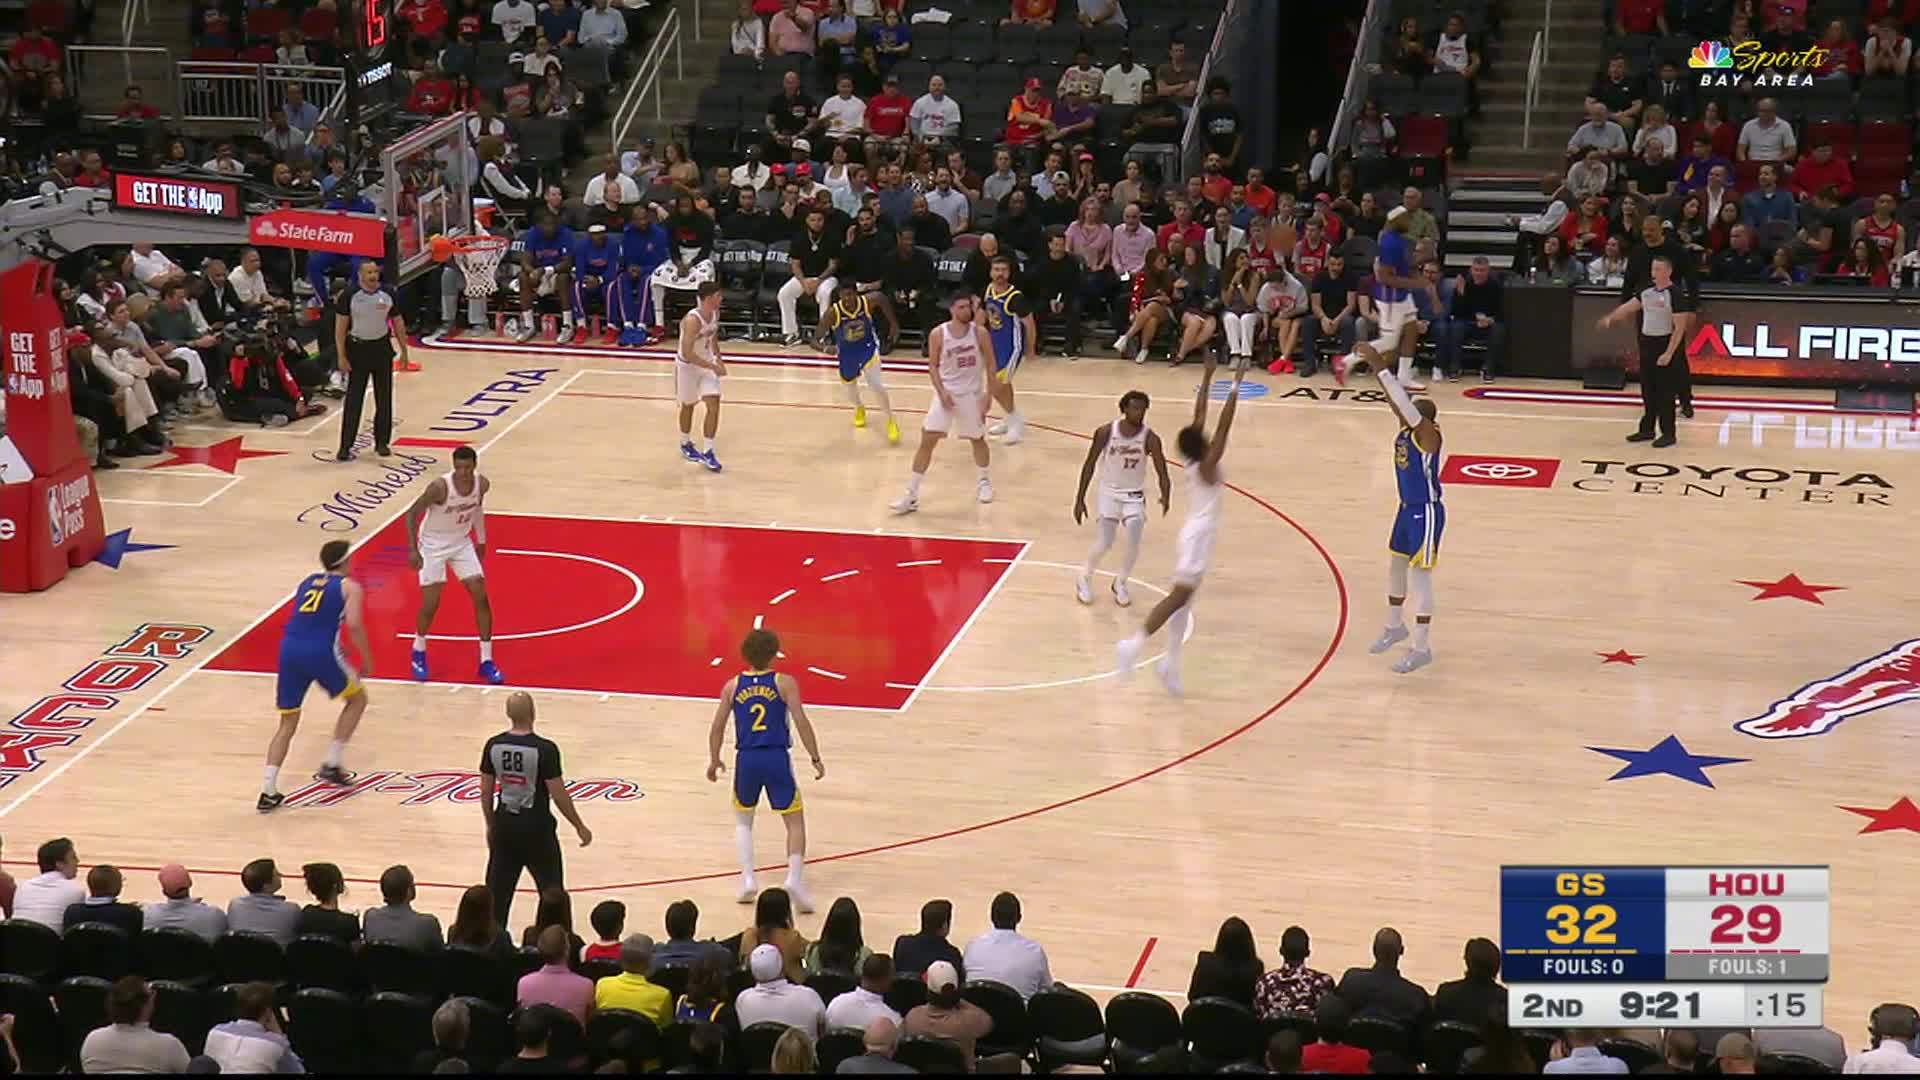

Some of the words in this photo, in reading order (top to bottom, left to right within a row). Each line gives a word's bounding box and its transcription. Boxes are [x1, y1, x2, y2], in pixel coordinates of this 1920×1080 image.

[133, 181, 158, 205] GET
[160, 183, 186, 208] THE
[198, 188, 223, 215] App
[279, 221, 317, 240] State
[317, 226, 354, 245] Farm
[10, 332, 34, 353] GET
[1686, 323, 1789, 358] ALL
[1799, 325, 1920, 362] FIRE
[11, 352, 37, 374] THE
[19, 374, 44, 400] App
[429, 368, 560, 432] ULTRA
[1280, 386, 1415, 404] AT&
[1123, 457, 1140, 469] 17
[1581, 459, 1894, 489] TOYOTA
[297, 451, 437, 533] Michelob
[1573, 478, 1894, 507] CENTER
[299, 588, 325, 613] 21
[0, 623, 214, 789] ROCK
[750, 703, 769, 732] 2
[502, 750, 523, 772] 28
